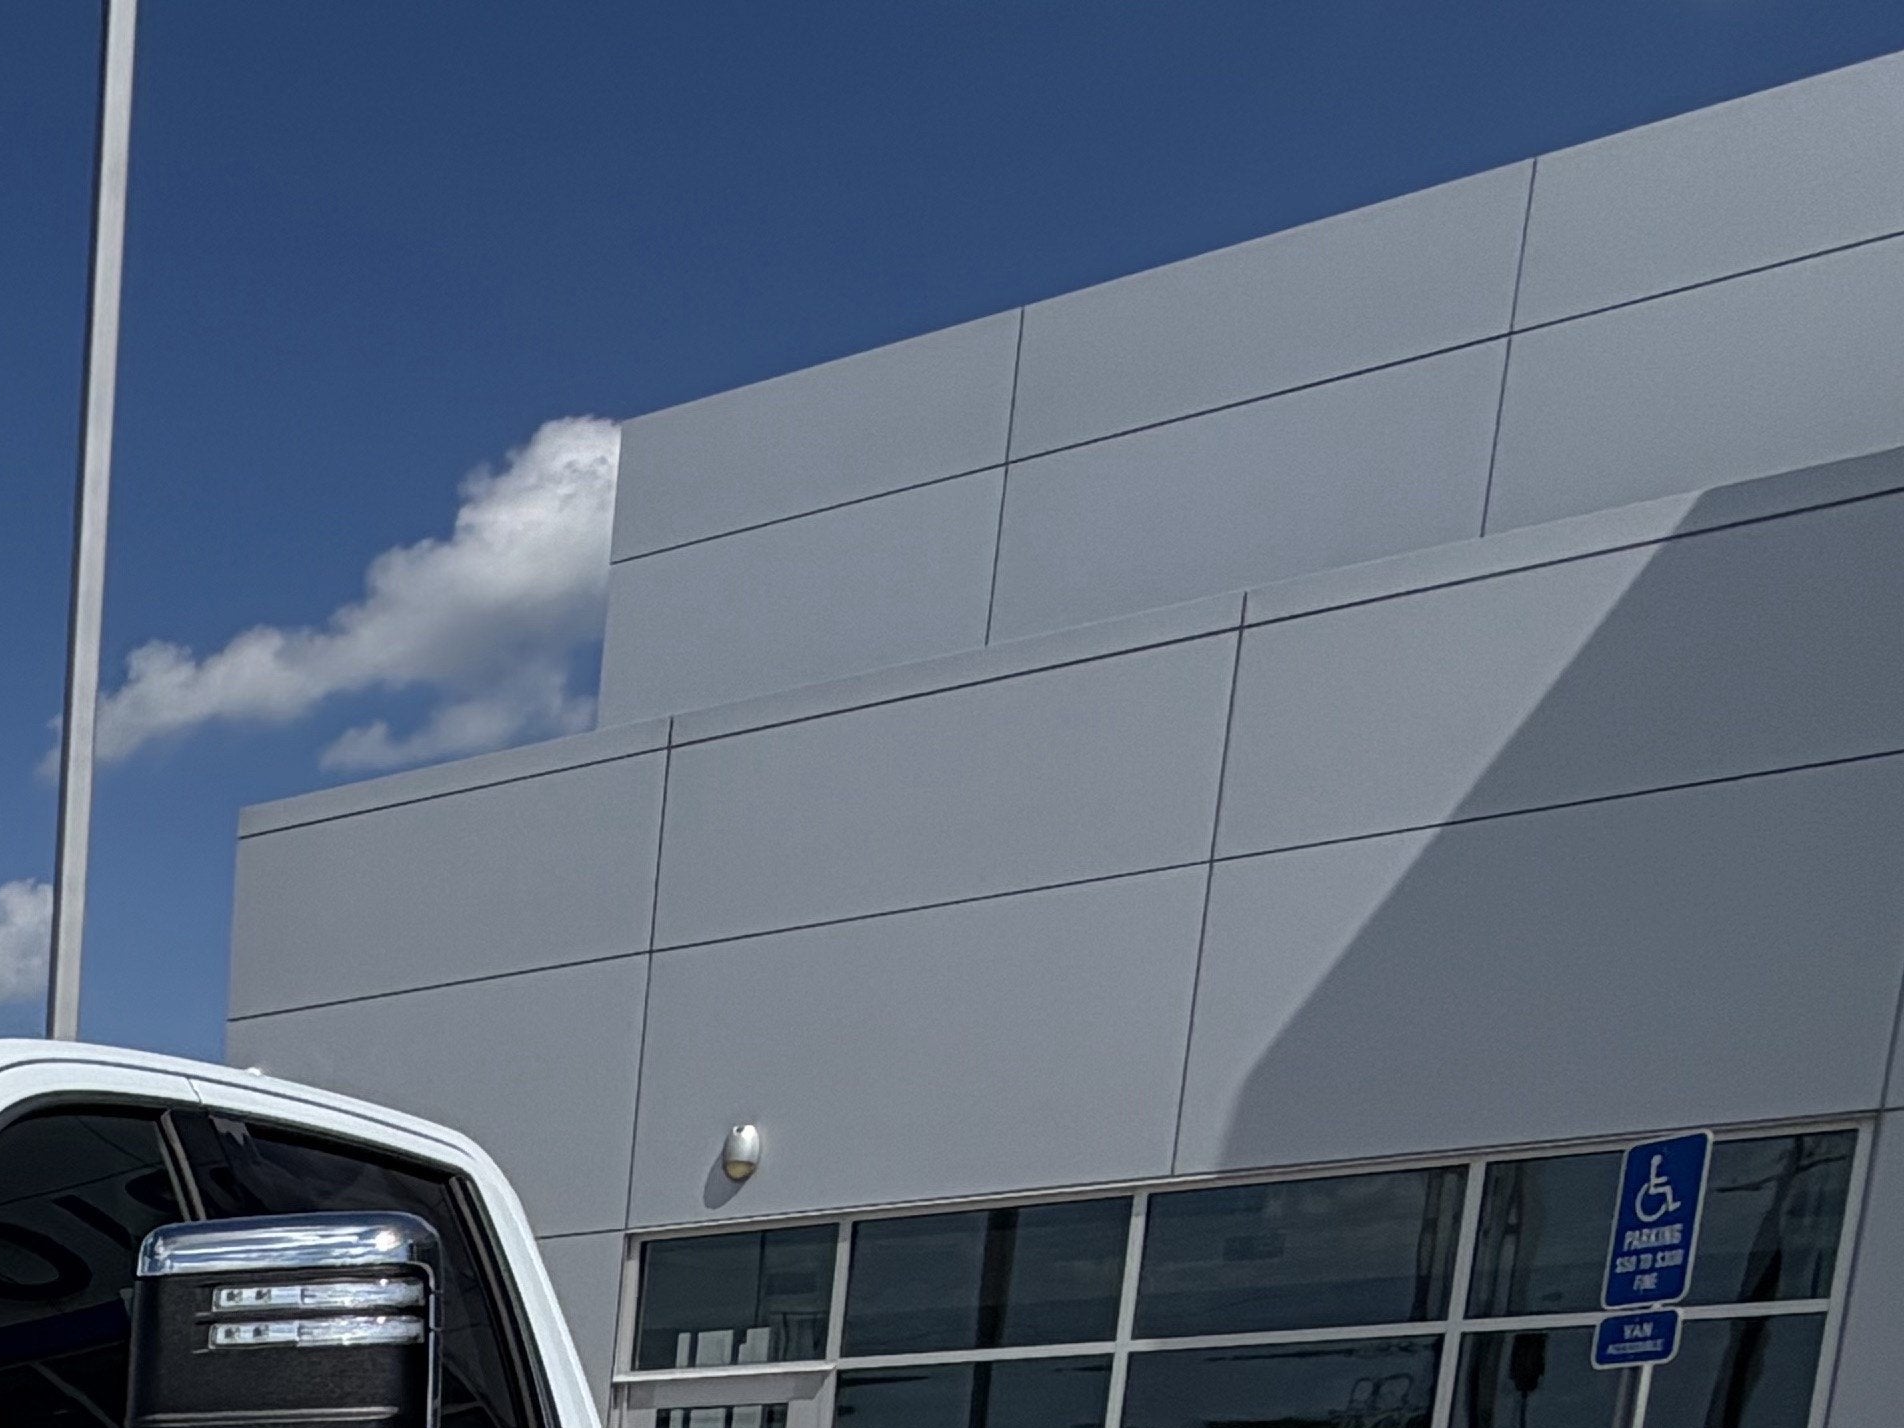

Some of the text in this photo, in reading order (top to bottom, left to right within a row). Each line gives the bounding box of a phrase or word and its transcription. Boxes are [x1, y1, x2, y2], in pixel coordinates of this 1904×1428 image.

[1623, 1223, 1683, 1251] PARKING
[1639, 1253, 1652, 1269] TO
[1633, 1273, 1658, 1290] FINE
[1624, 1322, 1653, 1339] VAN
